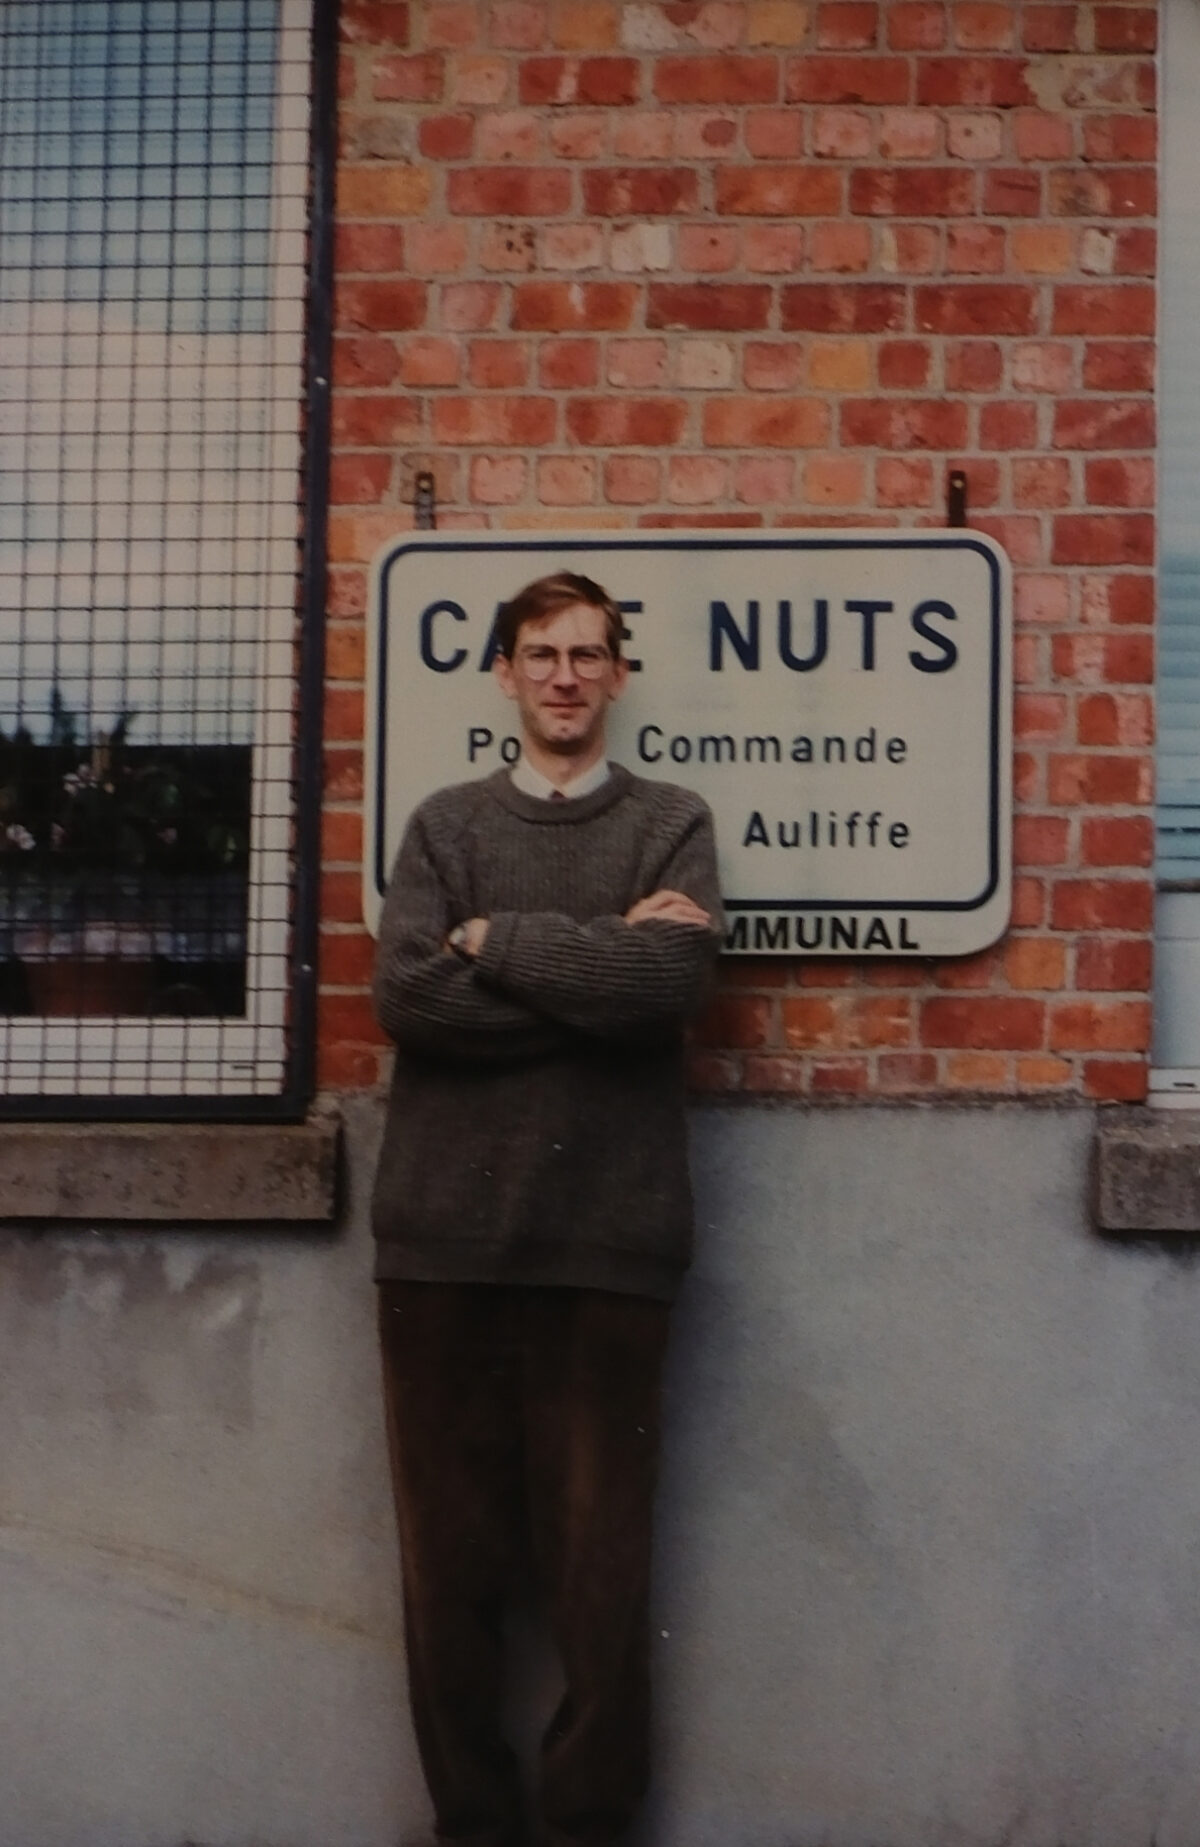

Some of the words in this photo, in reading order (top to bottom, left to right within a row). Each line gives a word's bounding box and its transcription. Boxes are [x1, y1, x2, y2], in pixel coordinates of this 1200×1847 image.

[420, 600, 643, 673] CAE
[709, 599, 959, 673] NUTS
[638, 724, 908, 764] Commande
[743, 811, 911, 849] Auliffe
[723, 916, 919, 951] MMUNAL
